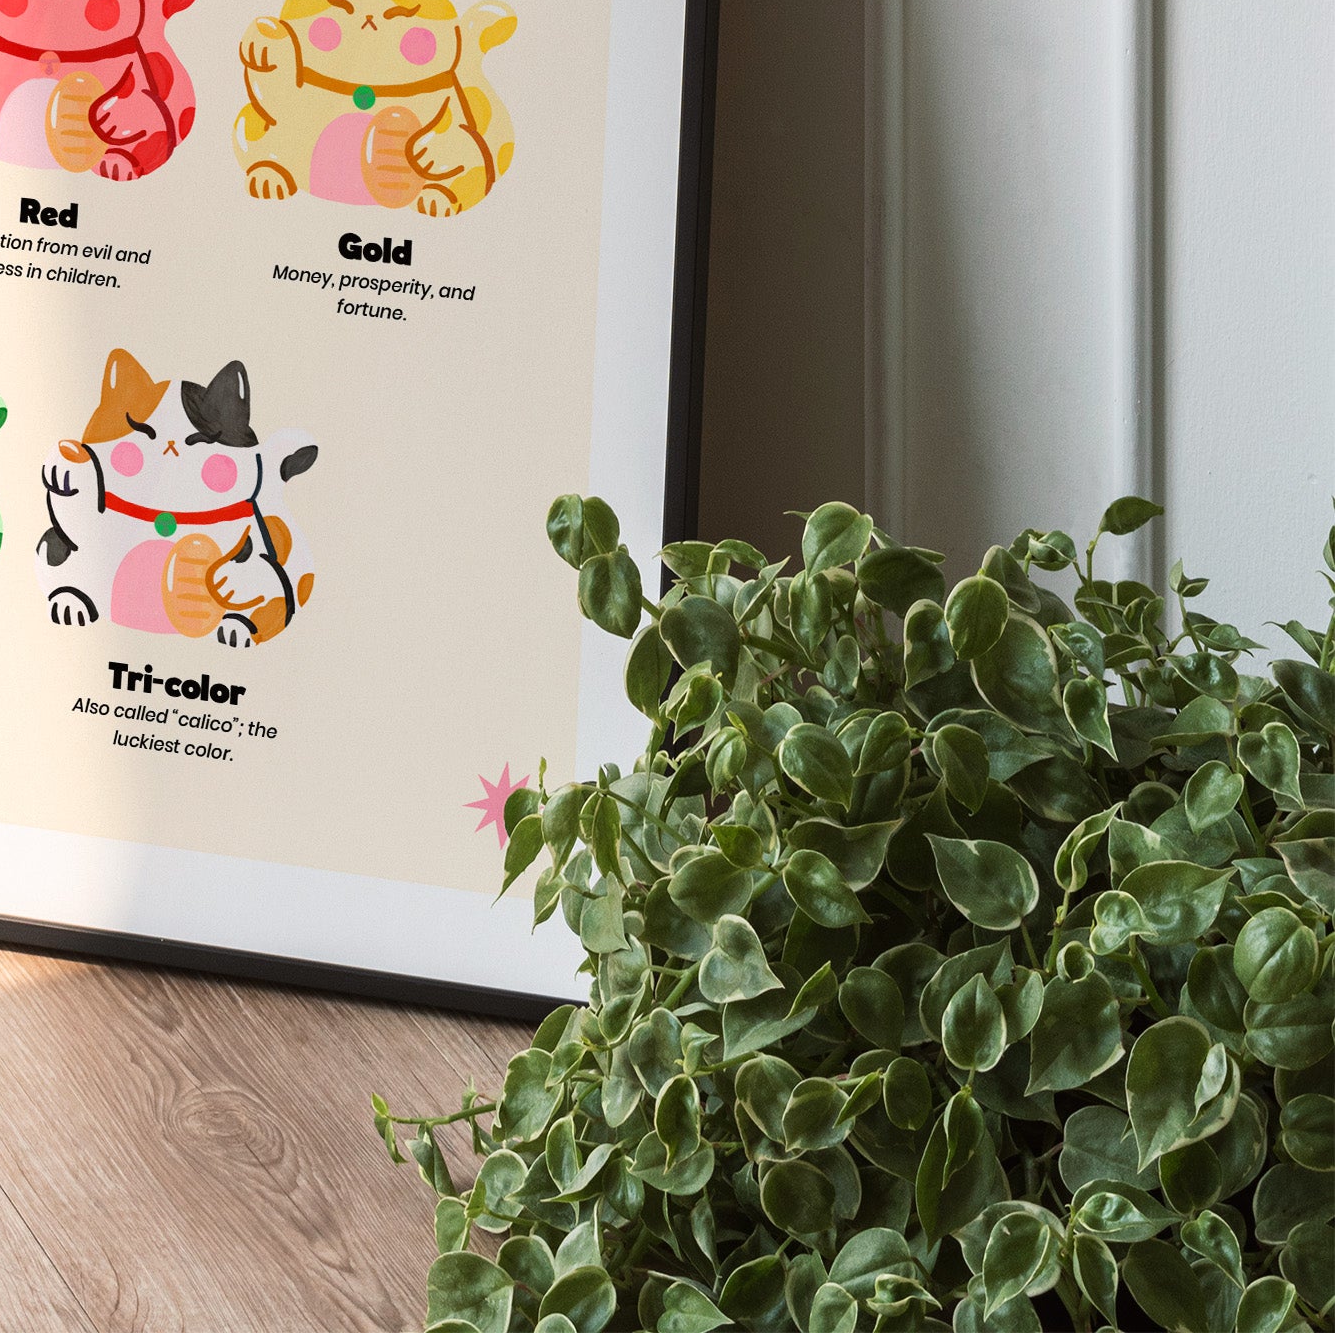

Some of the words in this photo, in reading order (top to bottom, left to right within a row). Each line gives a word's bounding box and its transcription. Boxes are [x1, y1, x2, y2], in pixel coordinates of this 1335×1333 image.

[19, 197, 79, 229] Red
[36, 237, 79, 257] from
[82, 244, 113, 260] evil
[115, 249, 152, 265] and
[337, 232, 413, 267] Gold
[26, 262, 42, 279] in
[46, 266, 121, 289] children.
[272, 264, 335, 290] Money,
[338, 274, 434, 301] prosperity,
[438, 285, 476, 301] and
[336, 298, 407, 321] fortune.
[108, 661, 247, 706] Tri-color
[71, 697, 110, 716] Also
[113, 704, 169, 724] called
[248, 721, 278, 739] the
[112, 729, 181, 754] luckiest
[184, 742, 233, 762] color.
